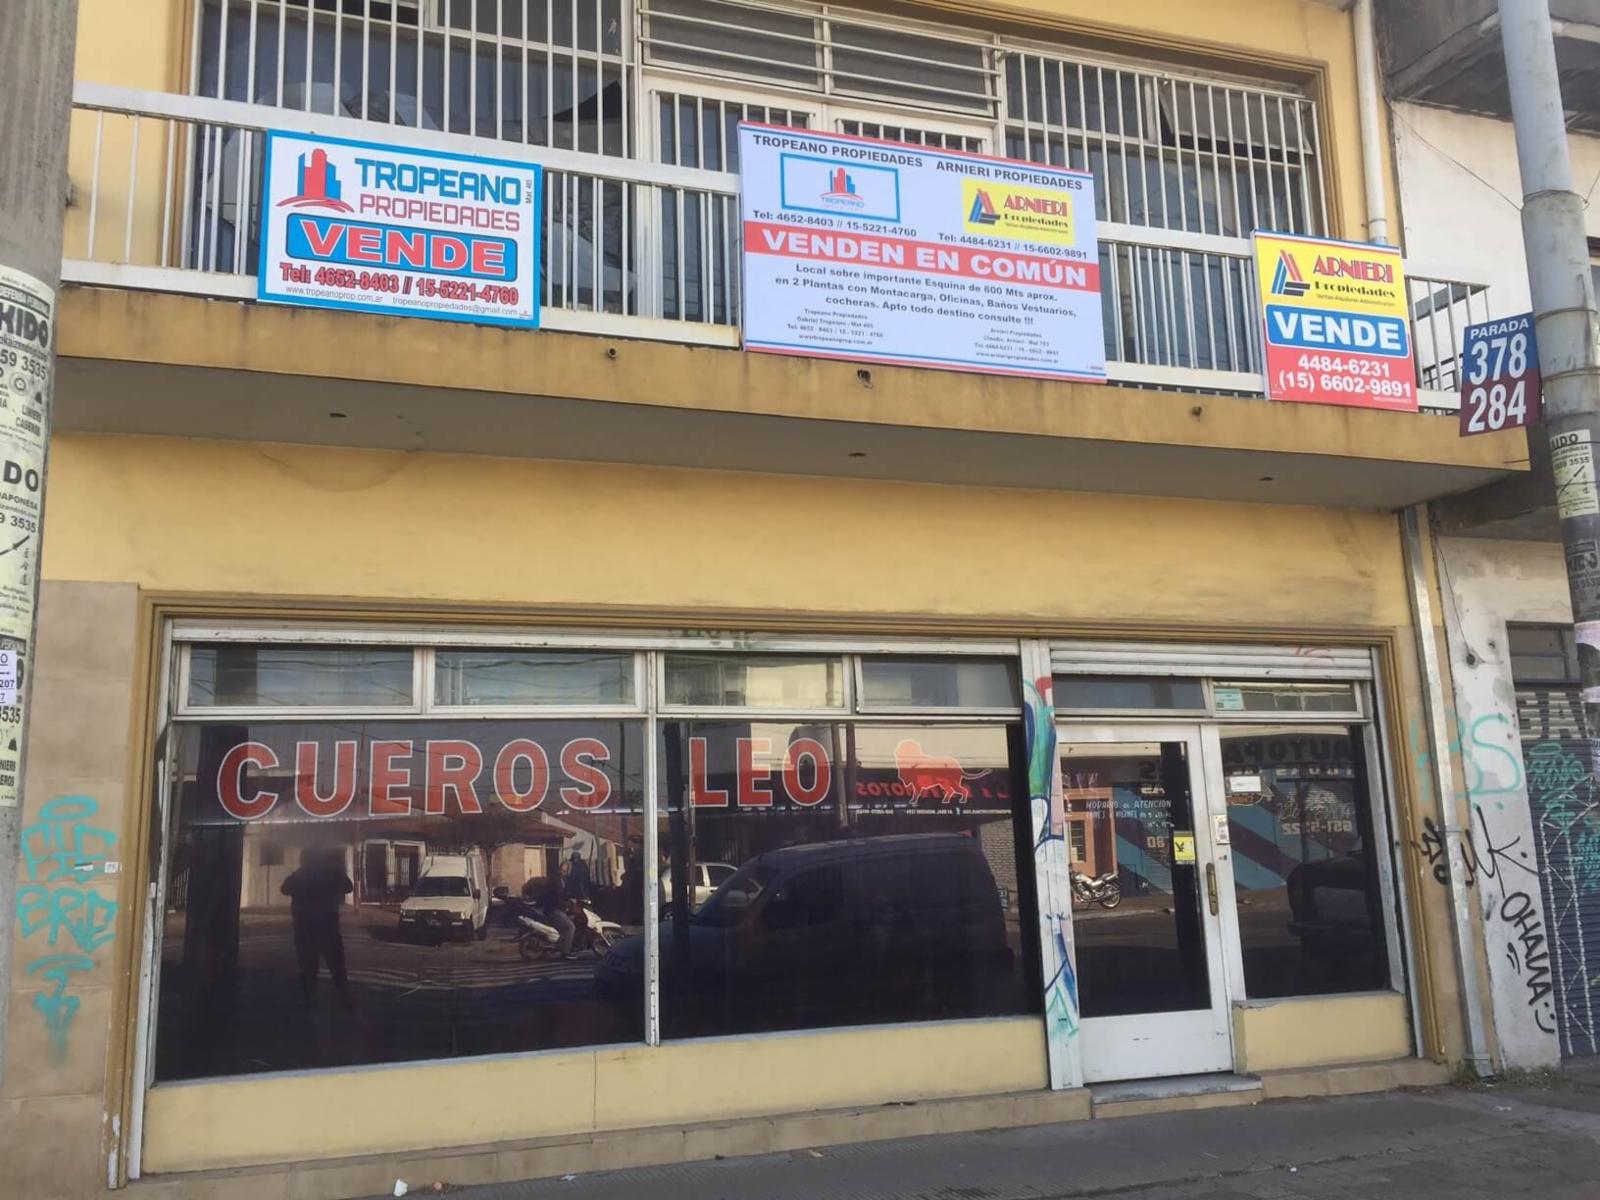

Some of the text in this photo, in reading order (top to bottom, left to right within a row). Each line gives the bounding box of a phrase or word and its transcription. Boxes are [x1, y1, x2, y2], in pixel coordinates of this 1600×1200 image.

[752, 134, 923, 168] TROPEANO PROPIEDADES
[355, 158, 521, 205] TROPEANO
[936, 161, 1083, 191] ARNIERI PROPIEDADES
[360, 194, 520, 231] PROPIEDADES
[1004, 194, 1068, 217] ARNIERI
[752, 210, 774, 221] Tel:
[776, 213, 834, 228] 4652-8403
[846, 221, 917, 237] 15-5221-4760
[300, 219, 506, 276] VENDE
[762, 229, 1087, 287] VENDEN EN COMÚN
[938, 232, 957, 243] Tel:
[959, 235, 1011, 249] 4484-6231
[1024, 244, 1087, 259] 15-6602-9891
[796, 263, 826, 275] Local
[830, 268, 860, 279] sobre
[864, 271, 922, 286] importante
[925, 278, 966, 293] Esquina
[969, 283, 981, 293] de
[984, 285, 1002, 295] 600
[1006, 288, 1024, 298] Mts
[1313, 254, 1394, 284] ARNIERI
[286, 286, 383, 304] www.tropeanoprop.com.ar
[393, 296, 518, 316] tropeanopropiedades@gmail.com
[314, 266, 399, 293] 4652-8403
[416, 278, 519, 306] 15-5221-4760
[775, 278, 789, 286] en
[793, 277, 800, 286] 2
[803, 279, 844, 291] Plantas
[847, 284, 867, 293] con
[1021, 304, 1077, 318] Vestuarios,
[1314, 281, 1395, 298] Propiedades
[882, 301, 907, 313] Apto
[910, 304, 934, 315] todo
[937, 307, 975, 319] destino
[978, 312, 1021, 324] consulte
[1273, 311, 1402, 351] VENDE
[1470, 318, 1529, 340] PARADA
[21, 356, 47, 380] 3535
[1298, 354, 1390, 378] 4484-6231
[1469, 333, 1527, 385] 378
[1279, 370, 1412, 398] (15) 6602-9891
[1467, 381, 1527, 433] 284
[10, 515, 37, 534] 3535
[217, 737, 831, 820] CUEROS LEO
[1500, 891, 1552, 1006] OHANA
